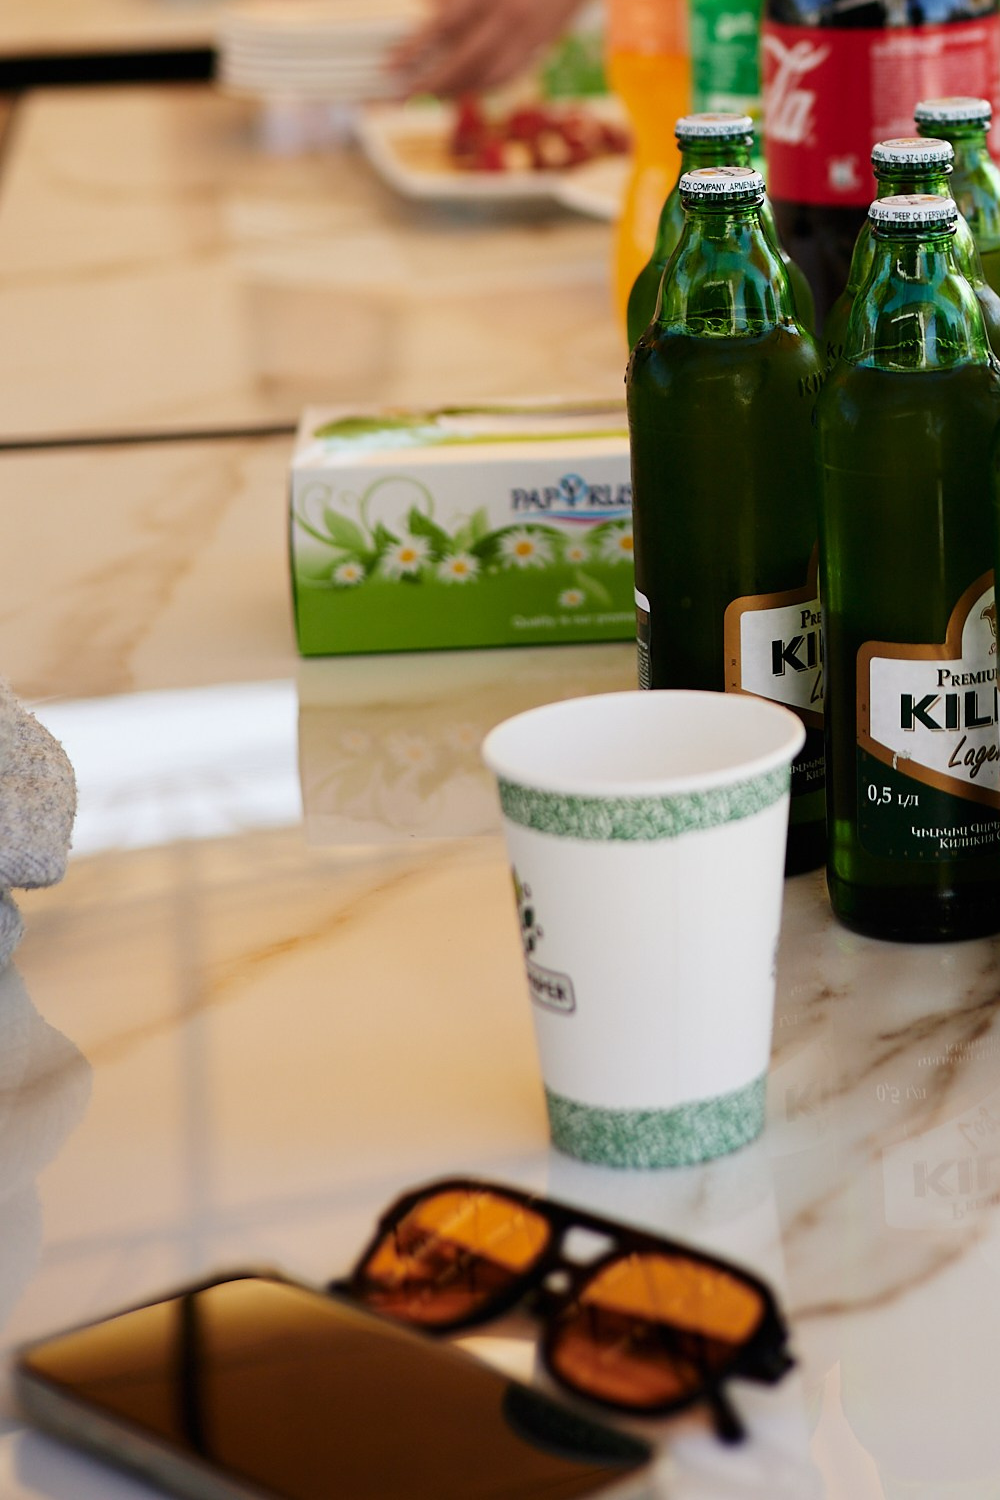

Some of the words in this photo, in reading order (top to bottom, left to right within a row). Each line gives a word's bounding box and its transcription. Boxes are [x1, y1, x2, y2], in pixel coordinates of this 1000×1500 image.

[692, 182, 726, 192] COMPANY
[913, 211, 922, 220] OF
[772, 629, 823, 677] KI
[900, 687, 998, 732] KIL
[868, 784, 892, 806] 0,5
[940, 833, 994, 850] КИЛИКИЯ
